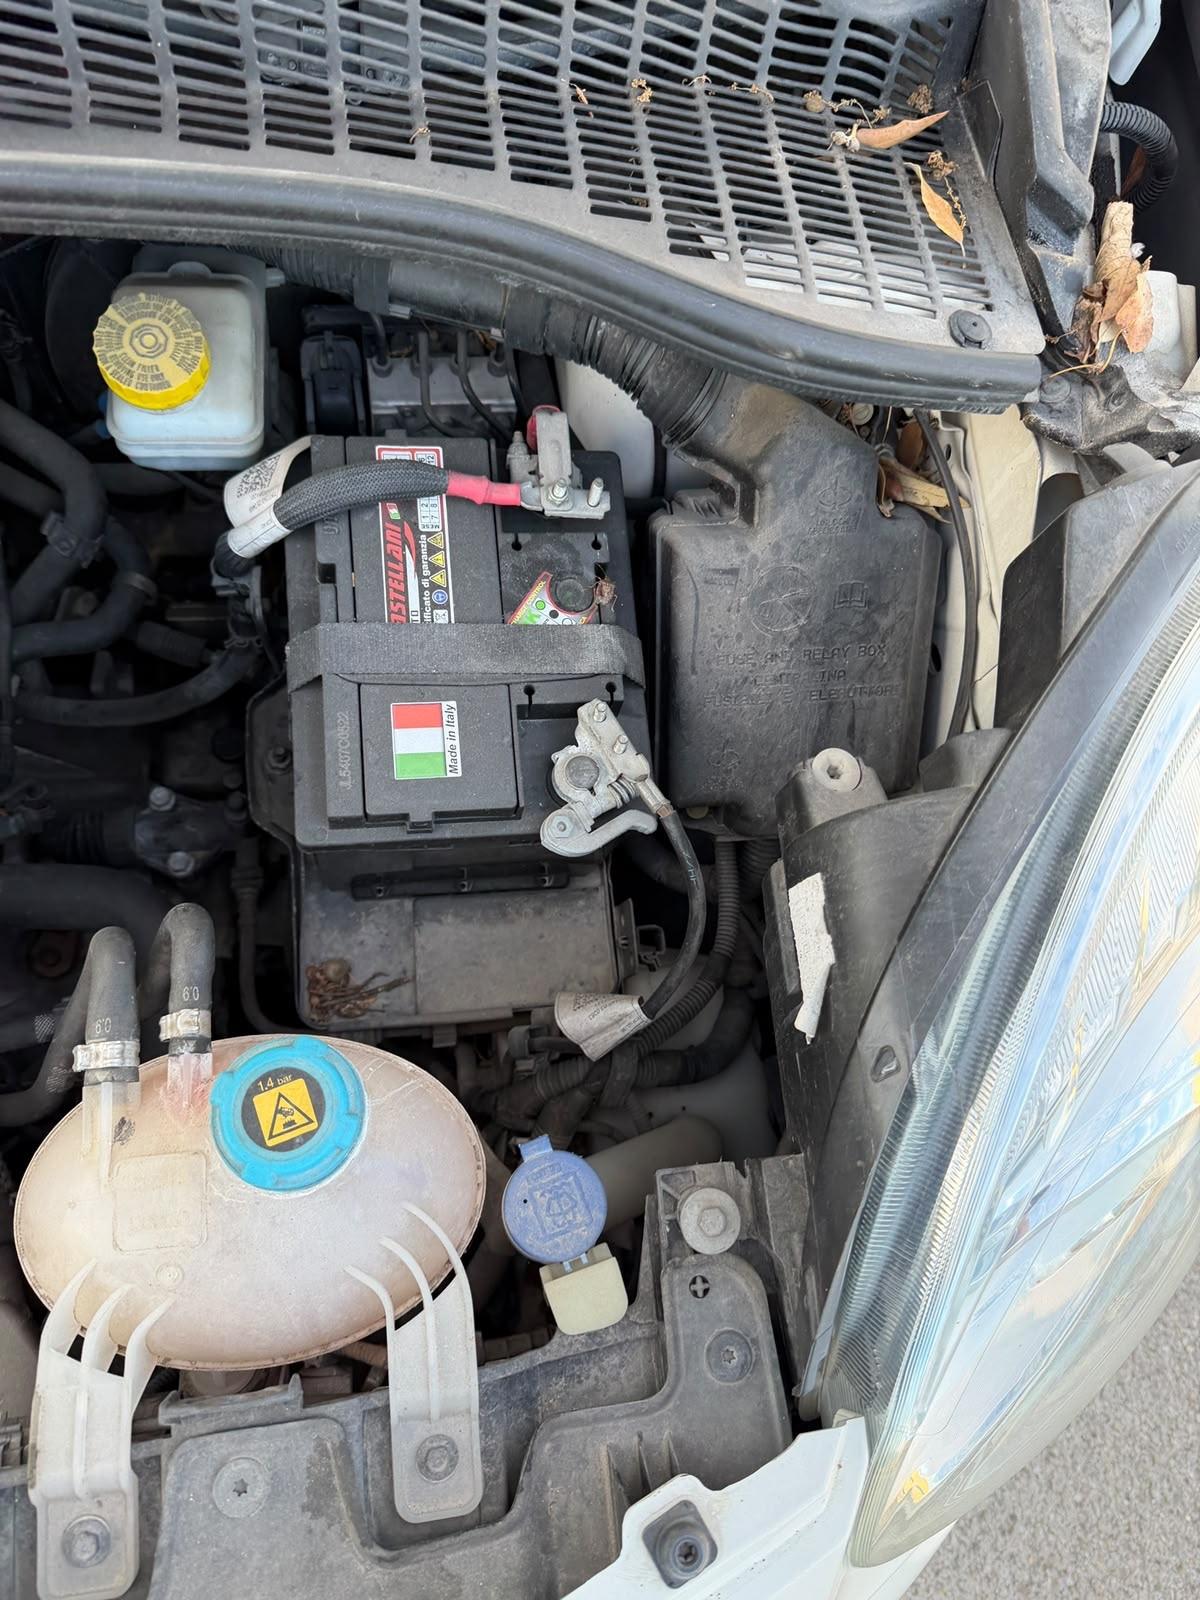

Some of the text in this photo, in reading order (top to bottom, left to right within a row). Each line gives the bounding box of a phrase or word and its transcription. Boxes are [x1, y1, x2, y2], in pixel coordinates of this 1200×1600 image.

[419, 534, 430, 577] garanzia
[386, 521, 406, 624] ASTELLANI
[420, 577, 430, 588] di
[803, 646, 851, 662] RELAY
[857, 643, 886, 658] BOX
[444, 703, 460, 775] Made in Italy
[257, 1073, 293, 1092] 1.4 bar
